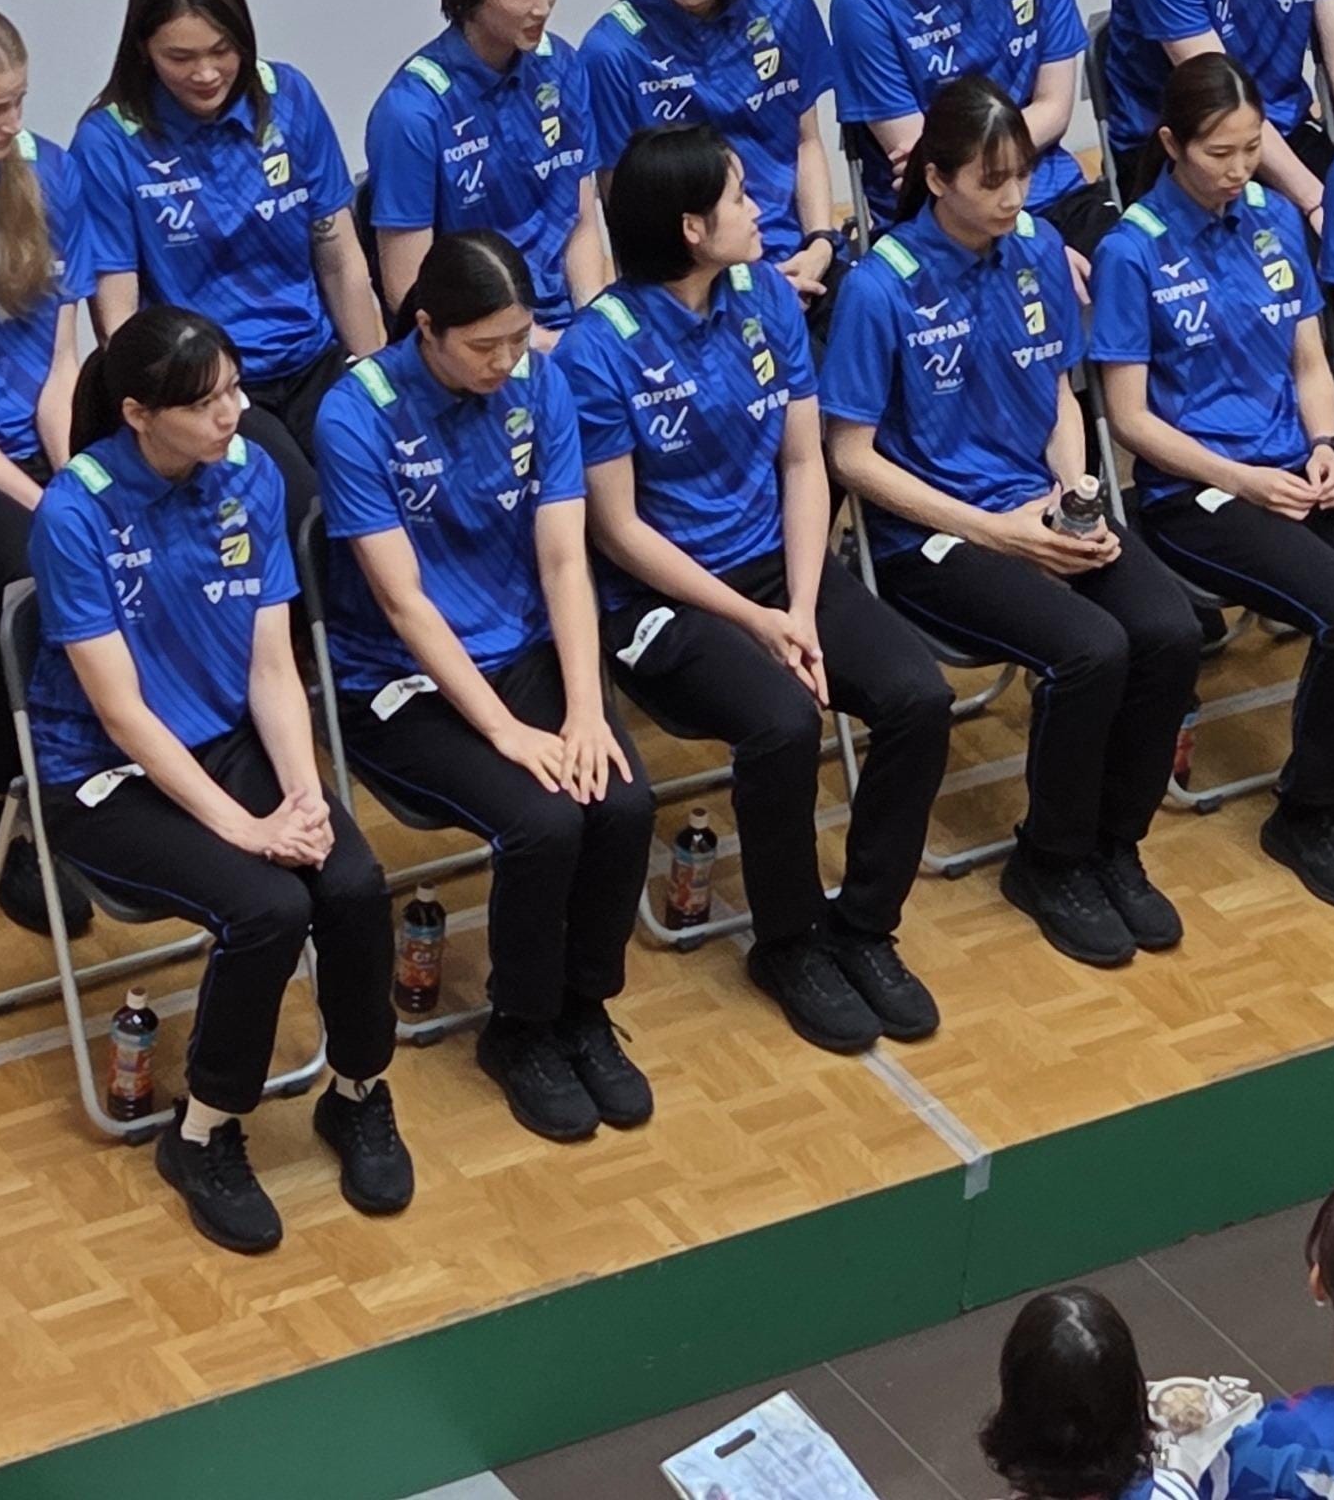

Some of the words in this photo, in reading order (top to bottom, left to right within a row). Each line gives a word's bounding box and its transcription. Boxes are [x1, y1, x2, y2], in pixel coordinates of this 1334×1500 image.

[1151, 277, 1210, 305] TOPPAN
[906, 317, 971, 348] TOPPAN
[631, 379, 698, 410] TOPPAN
